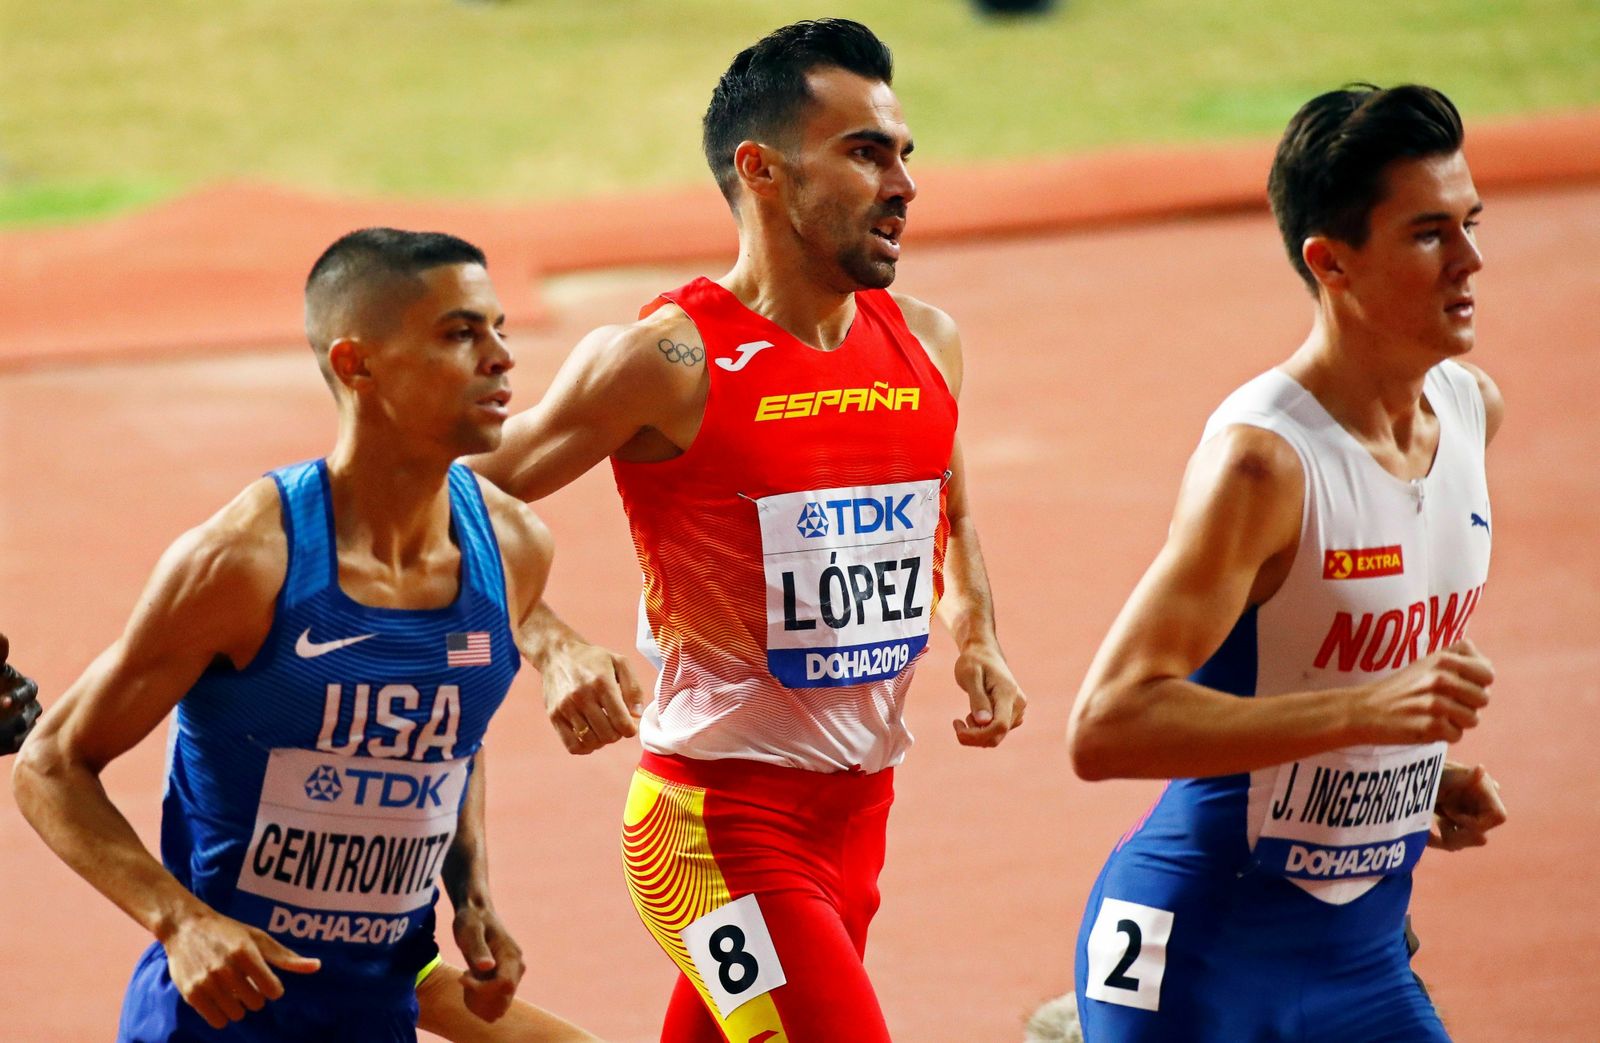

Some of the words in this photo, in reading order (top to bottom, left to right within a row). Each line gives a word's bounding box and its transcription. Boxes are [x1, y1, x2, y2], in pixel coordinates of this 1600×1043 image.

[754, 381, 920, 422] ESPAÑA
[827, 493, 916, 536] TDK
[1357, 553, 1401, 571] EXTRA
[781, 552, 924, 631] LÓPEZ
[1313, 582, 1486, 672] NORW
[806, 643, 909, 681] DOHA2019
[316, 684, 460, 759] USA
[345, 768, 450, 809] TDK
[1272, 762, 1299, 821] J.
[1300, 753, 1442, 828] INGEBRIGTSEN
[252, 823, 450, 896] CENTROWITZ
[1285, 839, 1406, 875] DOHA2019
[267, 906, 410, 945] DOHA2019
[708, 924, 759, 995] 8
[1103, 919, 1142, 992] 2
